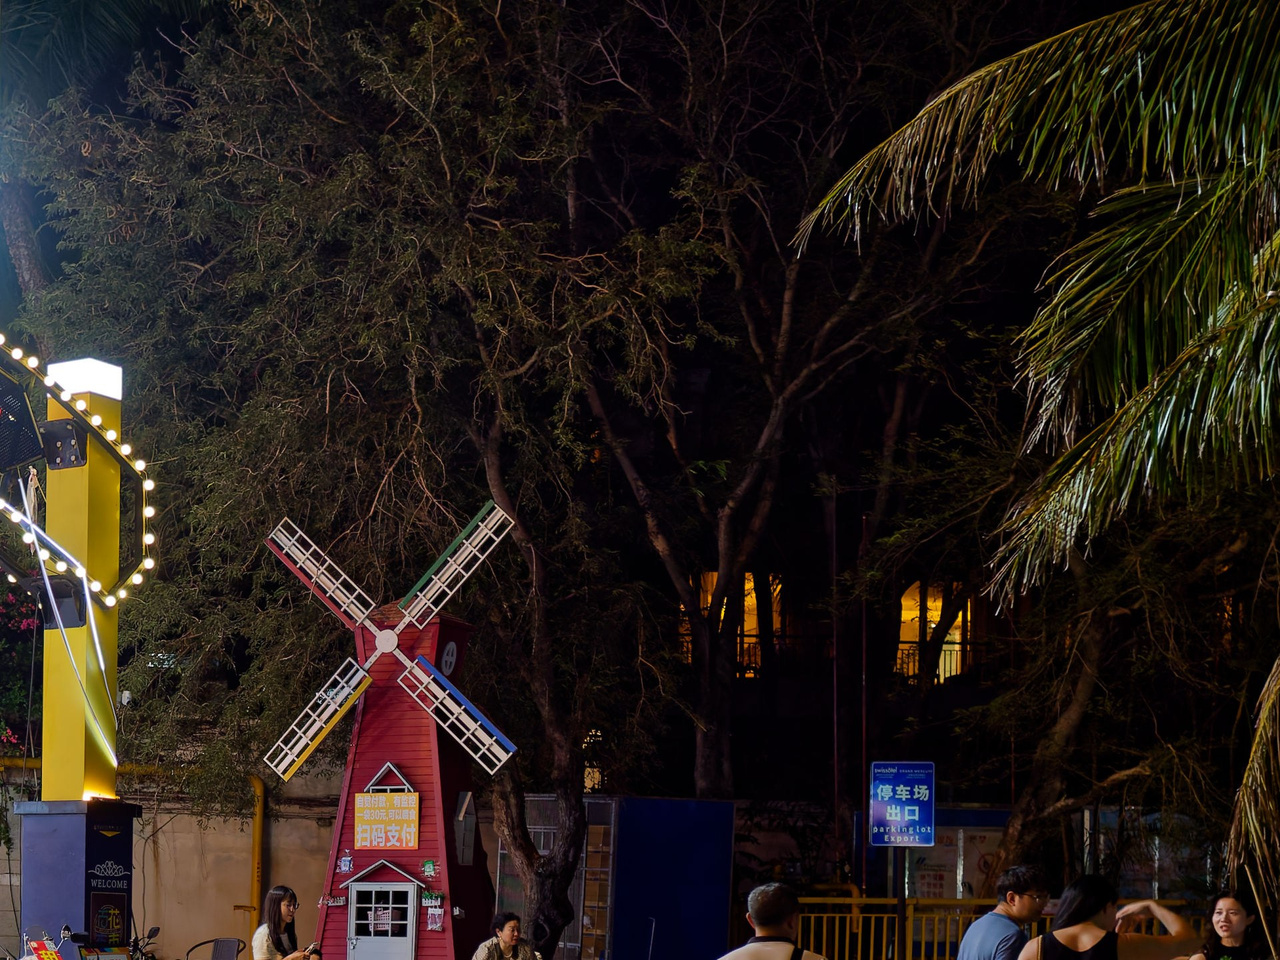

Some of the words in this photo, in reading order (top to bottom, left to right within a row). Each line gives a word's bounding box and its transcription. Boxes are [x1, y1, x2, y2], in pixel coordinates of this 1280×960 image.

[877, 784, 929, 801] 停车场
[886, 804, 919, 821] 出口
[356, 823, 416, 848] 扫码支付
[873, 826, 914, 834] parking
[884, 835, 920, 843] Export
[90, 878, 128, 889] WELCOME
